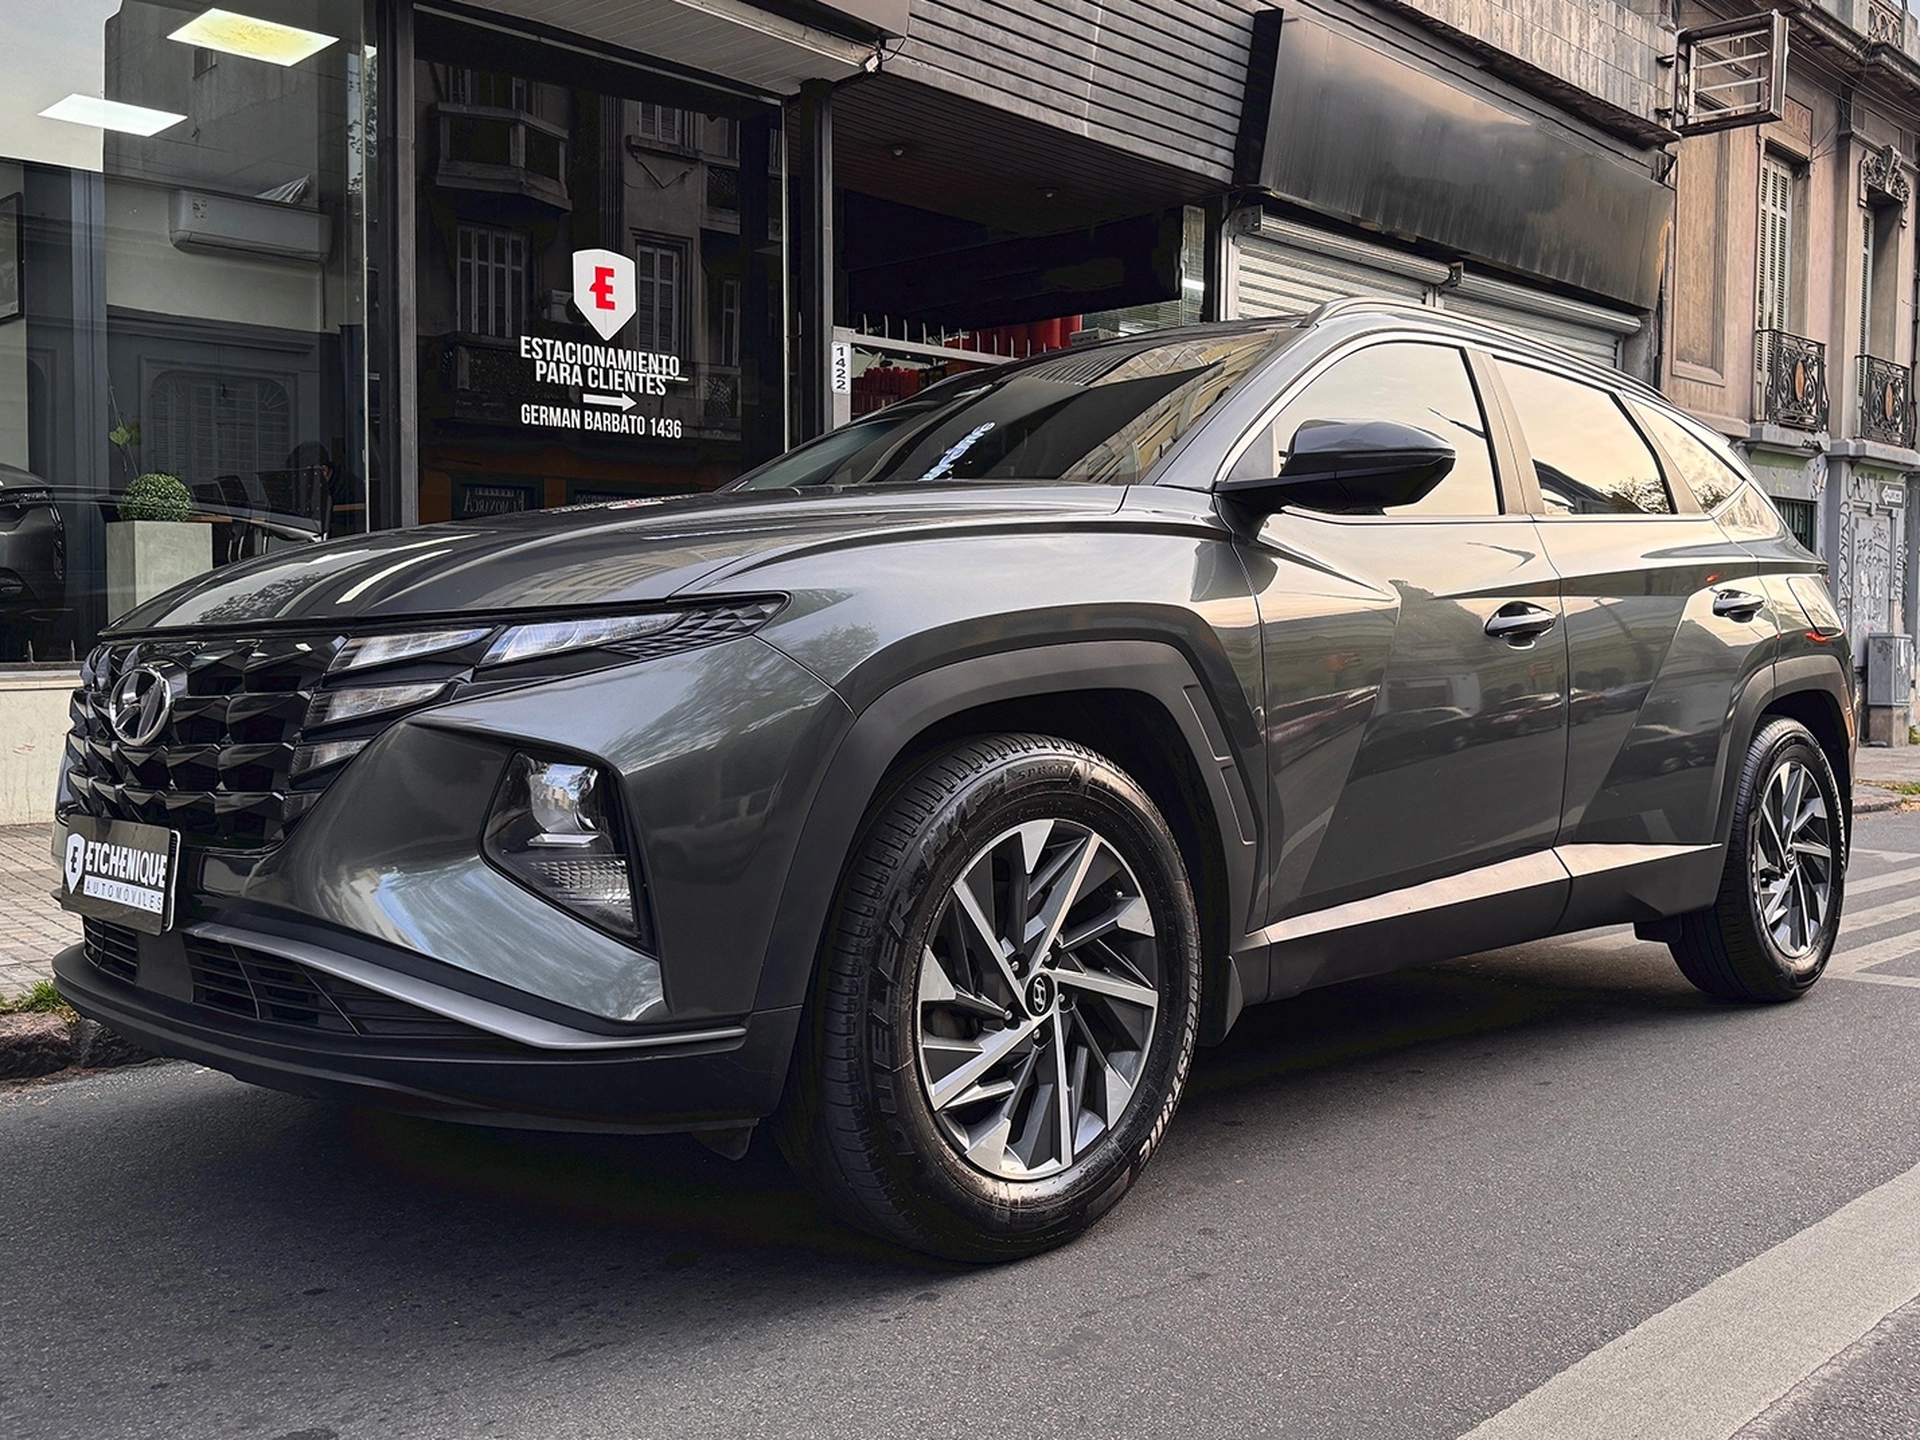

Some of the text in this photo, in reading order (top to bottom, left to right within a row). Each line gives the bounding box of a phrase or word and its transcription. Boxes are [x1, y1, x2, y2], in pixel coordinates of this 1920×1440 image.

[520, 335, 680, 377] ESTACIONAMIENTO
[835, 346, 846, 390] 1422
[535, 360, 666, 396] PARA CLIENTES
[521, 403, 682, 439] GERMAN BARBATO 1436
[85, 841, 168, 888] ETCHENIQUE
